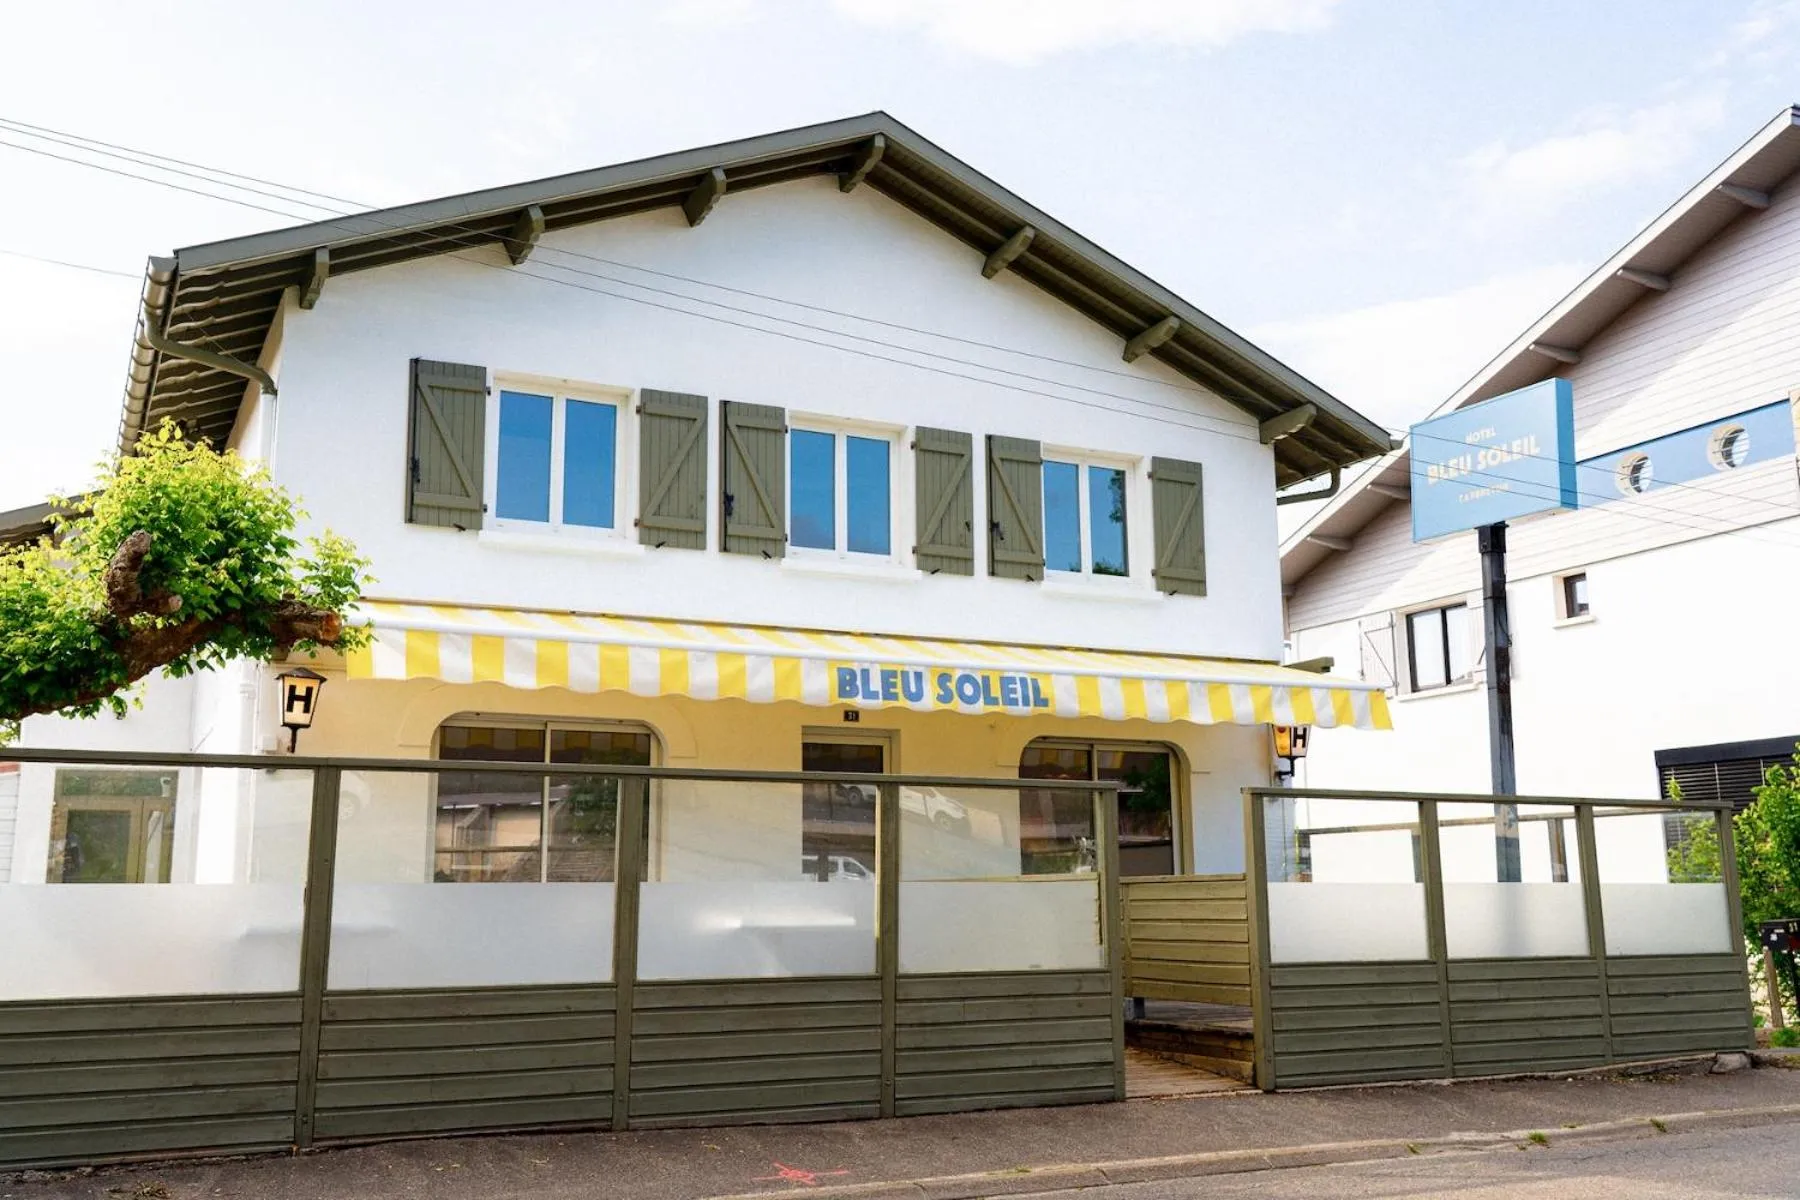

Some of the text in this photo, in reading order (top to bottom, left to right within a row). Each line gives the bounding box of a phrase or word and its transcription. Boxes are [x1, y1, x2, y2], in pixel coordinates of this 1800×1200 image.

[1427, 434, 1541, 485] BLEU SOLEIL
[286, 684, 314, 714] H
[837, 667, 1049, 708] BLEU SOLEIL
[1292, 725, 1308, 748] H
